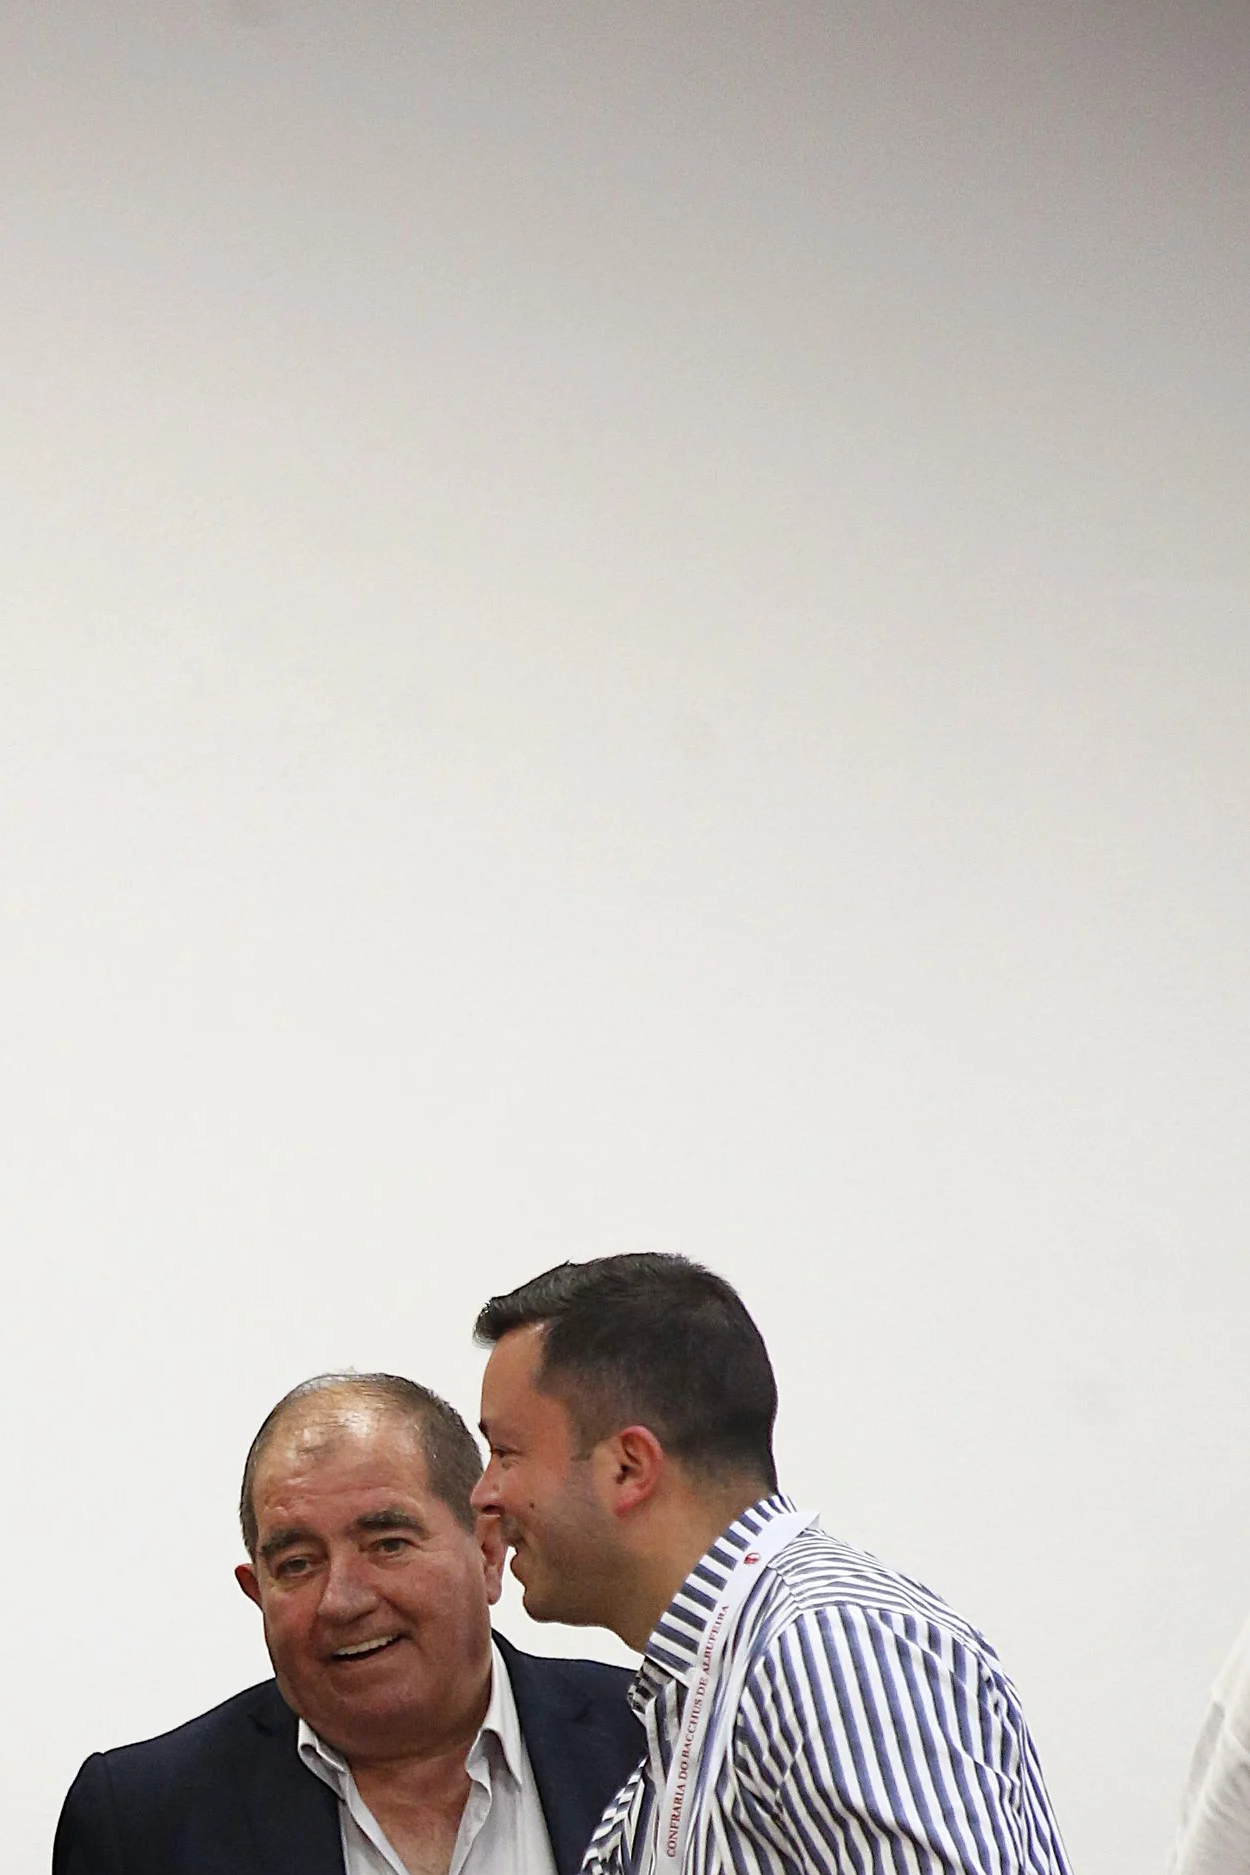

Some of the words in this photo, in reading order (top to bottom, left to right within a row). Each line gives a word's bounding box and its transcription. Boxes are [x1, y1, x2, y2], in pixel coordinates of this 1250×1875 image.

[702, 1604, 730, 1673] ALBUFEIRA
[697, 1674, 709, 1696] DE
[685, 1694, 703, 1763] BACCHUS
[678, 1762, 690, 1781] DO
[666, 1782, 686, 1858] CONFRARIA
